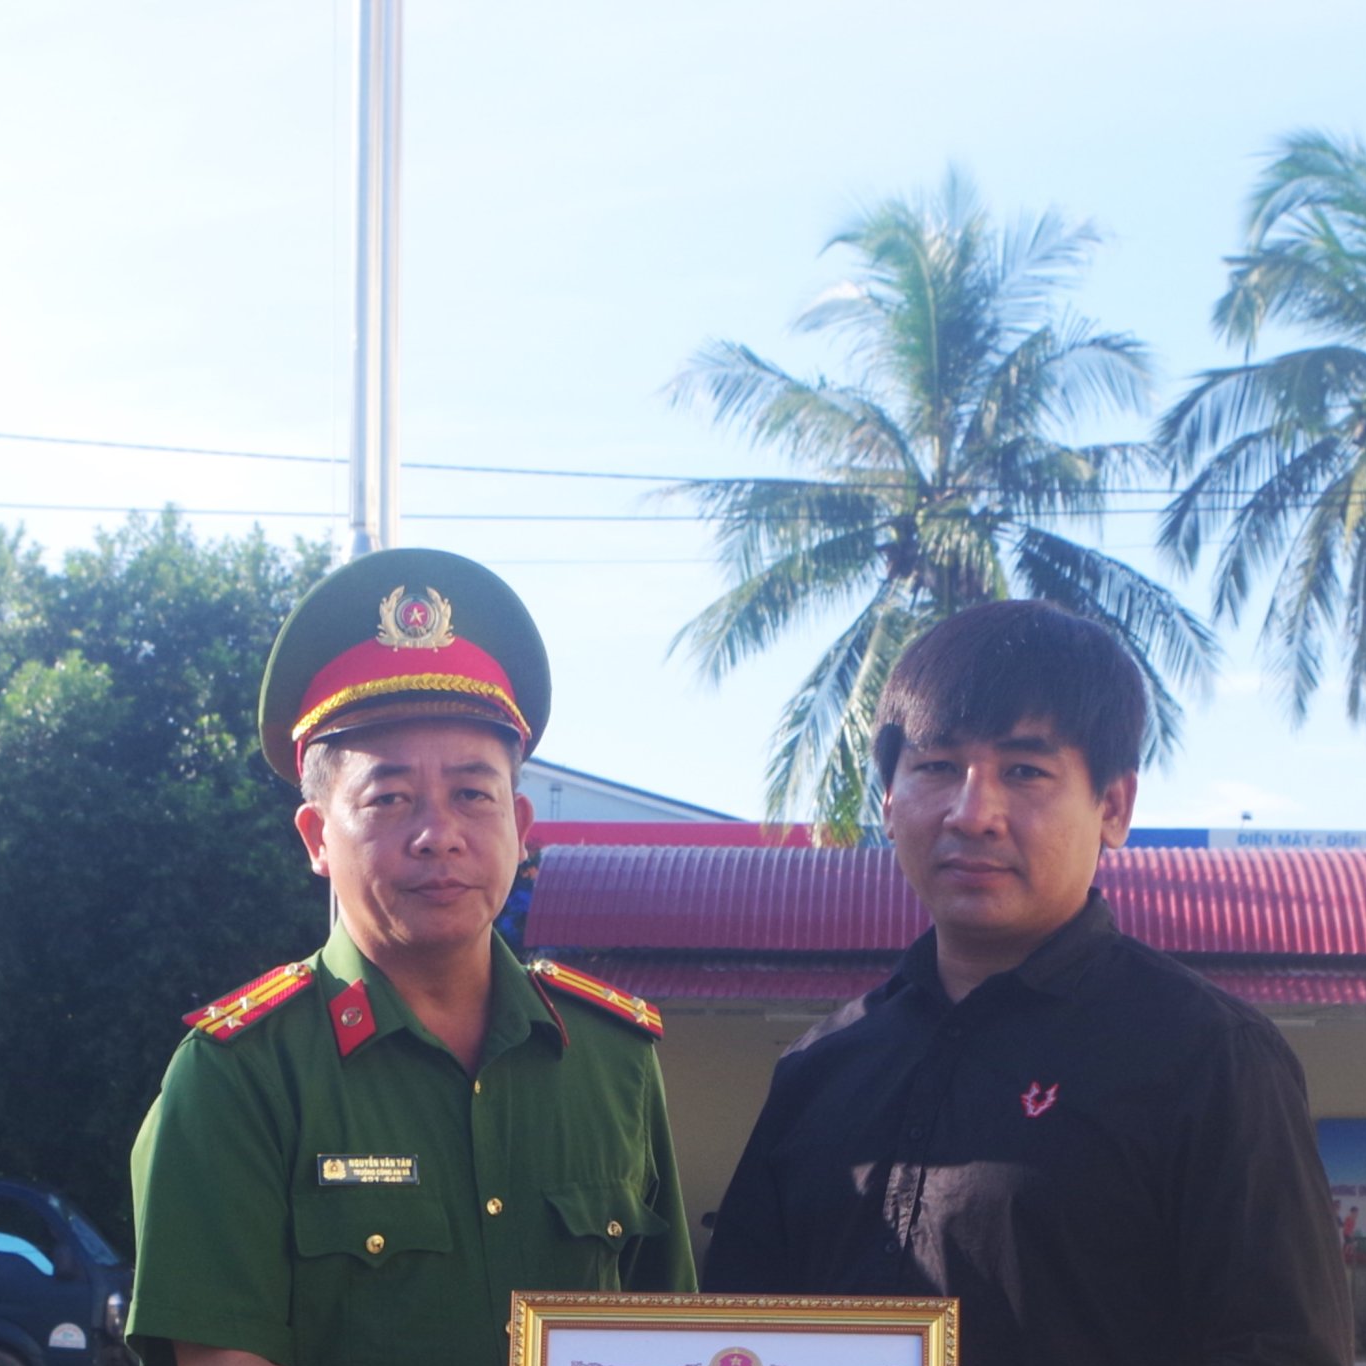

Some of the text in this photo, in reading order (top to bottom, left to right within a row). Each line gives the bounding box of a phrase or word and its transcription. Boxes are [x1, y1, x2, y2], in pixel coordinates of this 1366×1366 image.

[1237, 831, 1272, 847] ĐIỆN
[1278, 831, 1311, 847] MÁY
[1327, 832, 1361, 848] ĐIỆN
[348, 1155, 379, 1168] NGUYỄN
